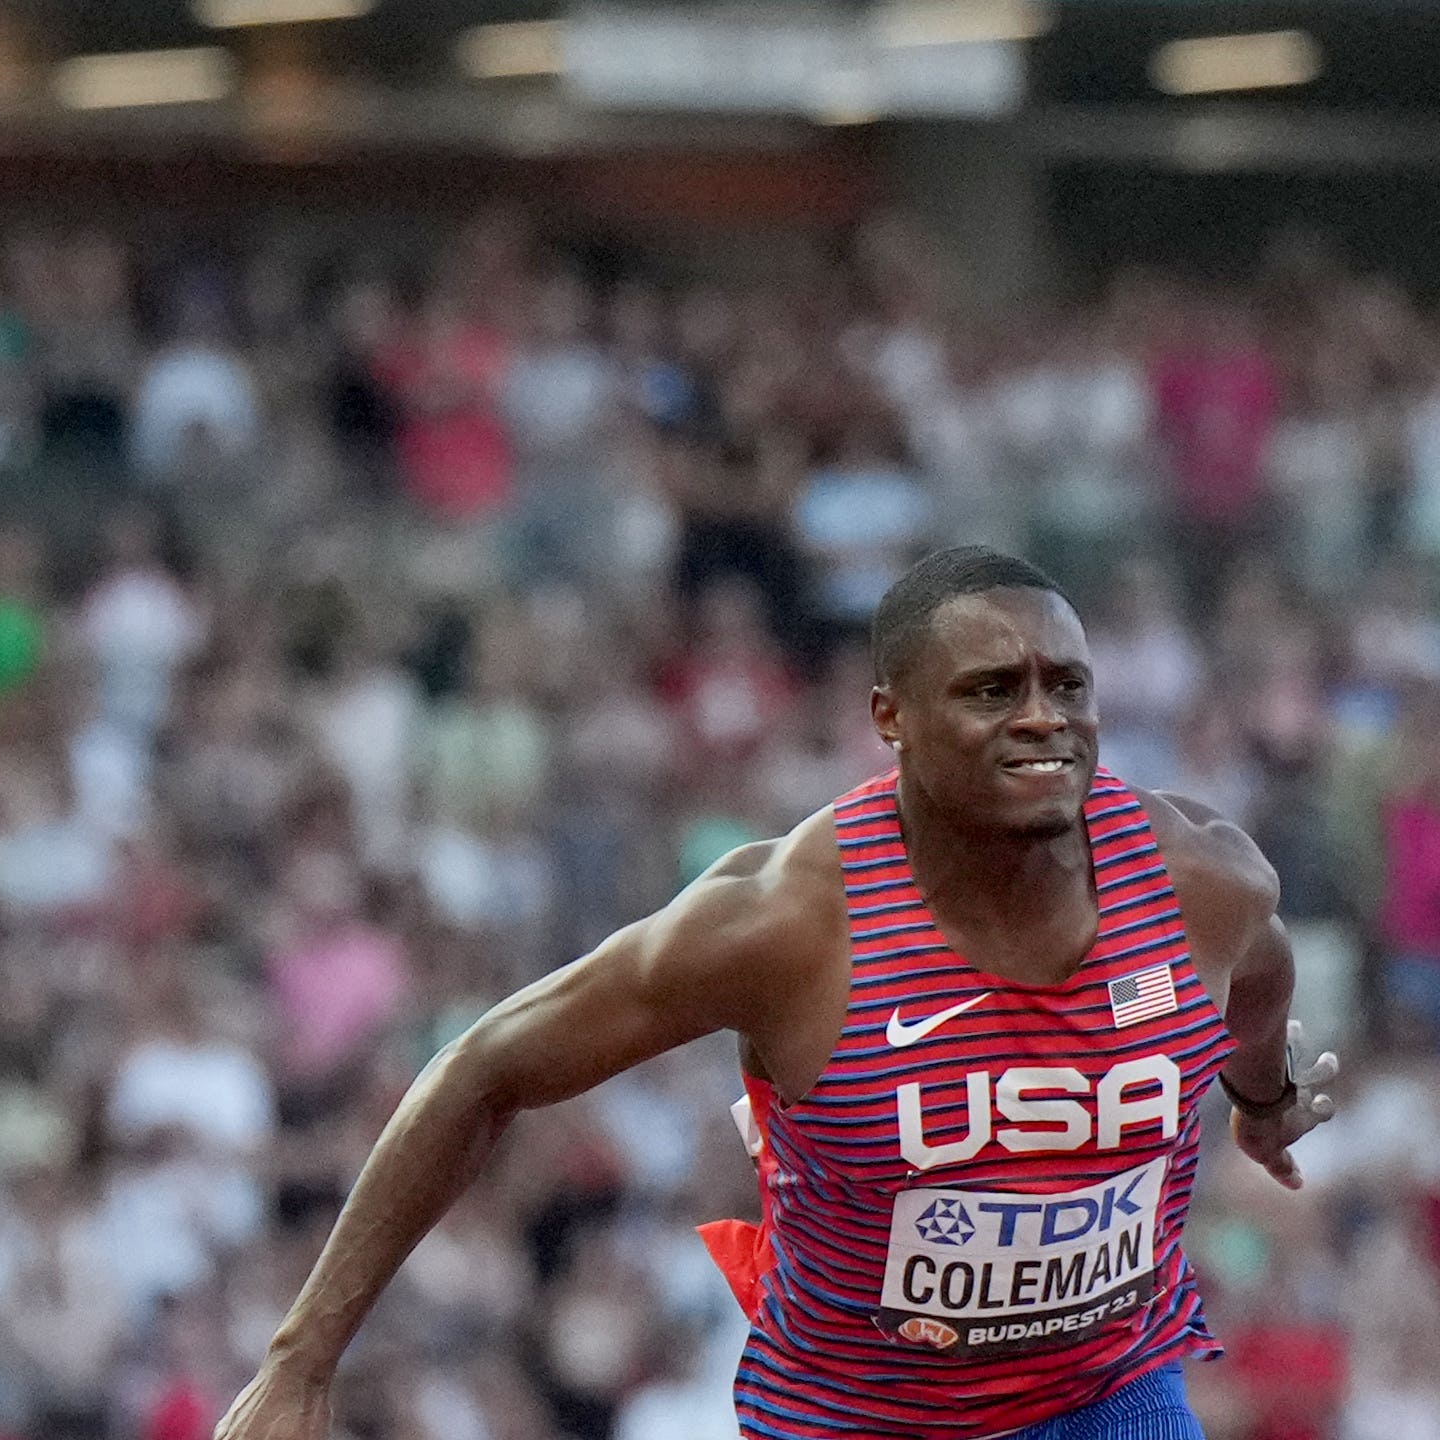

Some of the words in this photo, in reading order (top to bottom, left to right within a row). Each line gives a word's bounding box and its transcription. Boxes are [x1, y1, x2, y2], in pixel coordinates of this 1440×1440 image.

[896, 1054, 1181, 1170] USA
[978, 1169, 1149, 1247] TDK
[902, 1222, 1141, 1309] COLEMAN
[967, 1303, 1109, 1345] BUDAPEST
[1111, 1290, 1138, 1314] 23
